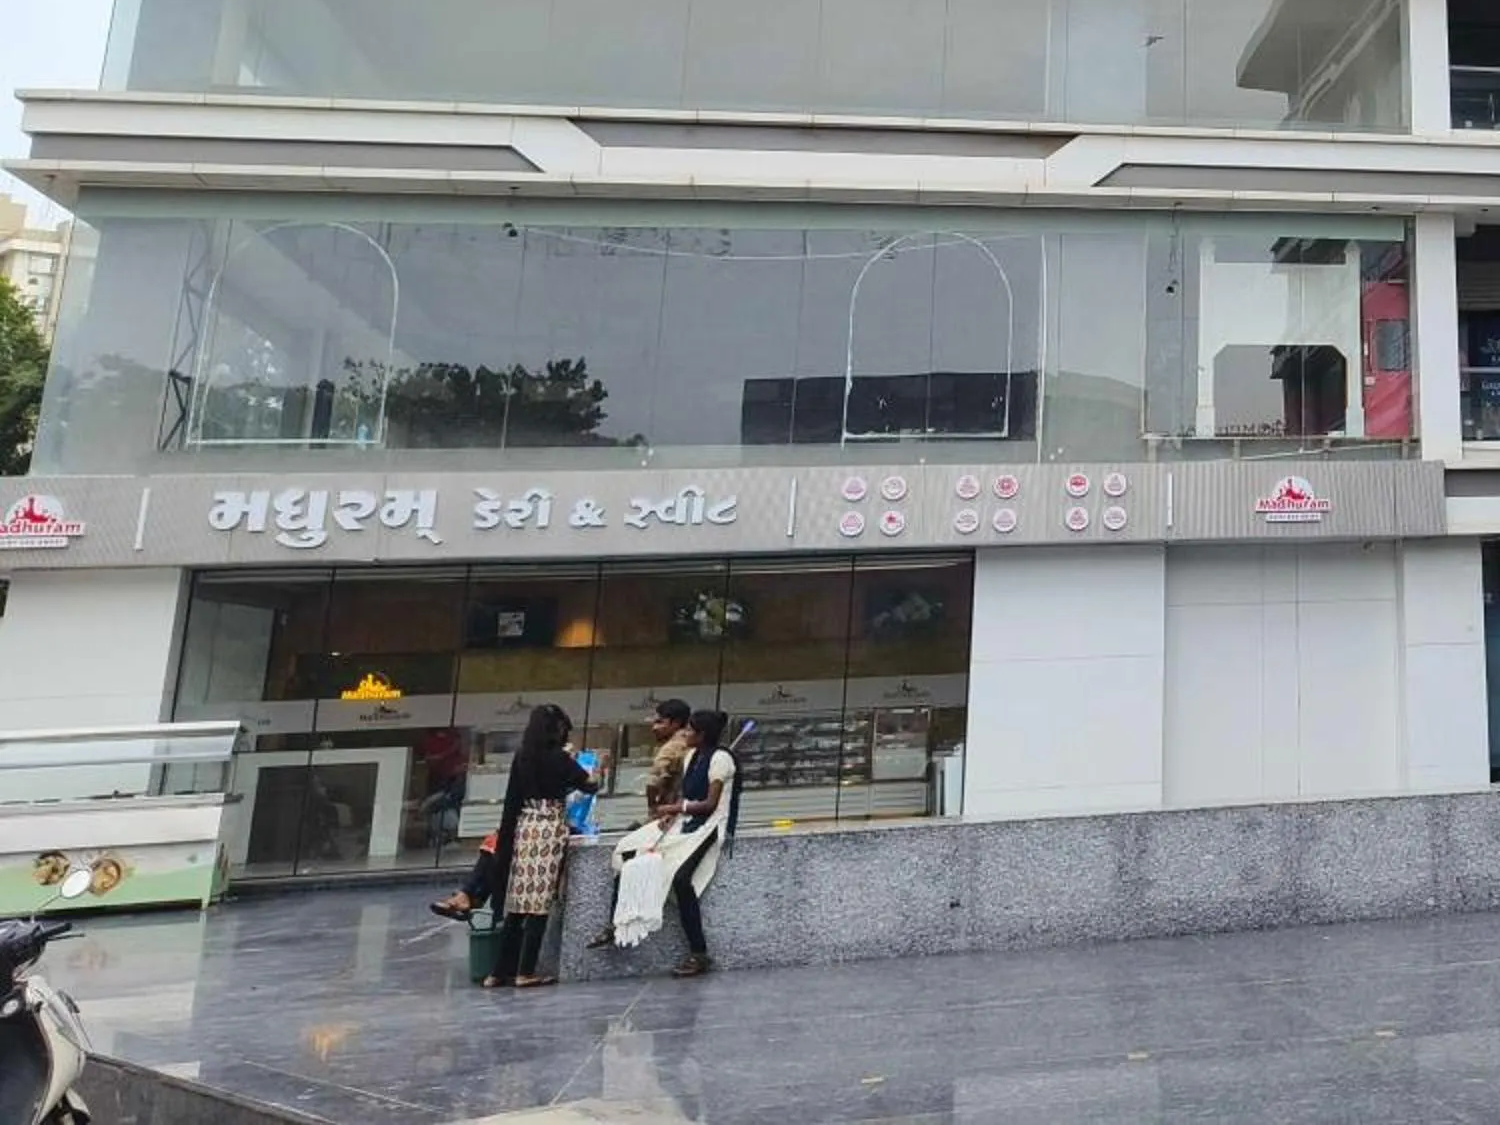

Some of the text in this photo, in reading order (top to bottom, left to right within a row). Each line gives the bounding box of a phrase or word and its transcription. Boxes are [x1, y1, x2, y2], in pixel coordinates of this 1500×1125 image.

[1259, 498, 1329, 510] Madhuram
[568, 499, 608, 528] &
[0, 520, 81, 534] adhuram
